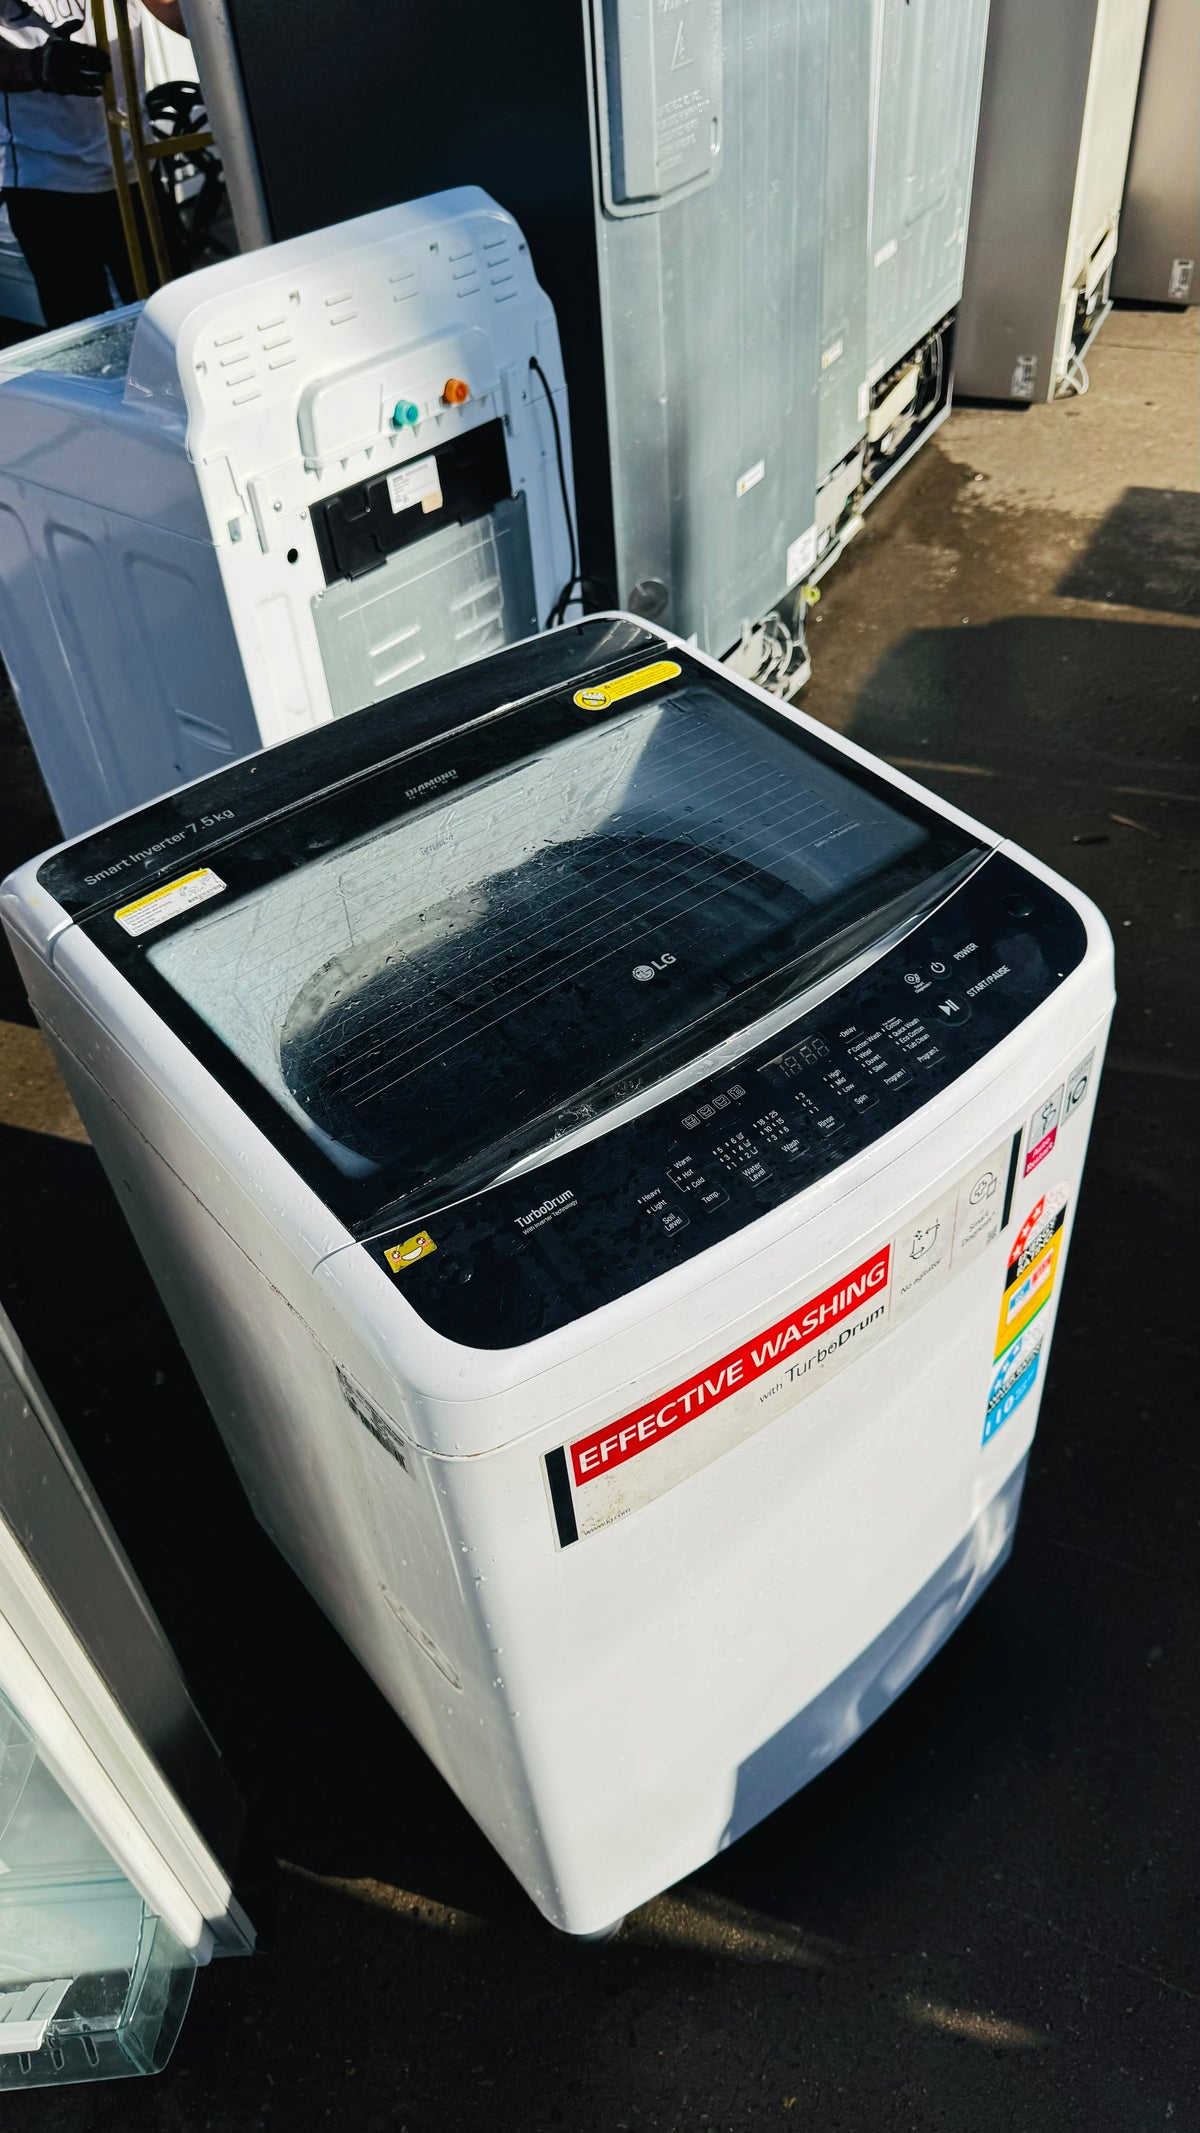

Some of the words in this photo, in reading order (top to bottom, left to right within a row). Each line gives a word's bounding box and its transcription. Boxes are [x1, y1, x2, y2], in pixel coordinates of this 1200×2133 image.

[405, 769, 457, 797] DIAMOND
[84, 859, 131, 885] Smart
[131, 830, 187, 862] Inverter
[953, 942, 979, 960] POWER
[651, 953, 677, 970] LG
[966, 965, 1011, 997] START/PAUSE
[885, 1019, 903, 1030] Cotton
[892, 1026, 907, 1037] Quick
[904, 1018, 920, 1029] Wash
[841, 1026, 857, 1038] Delay
[899, 1034, 911, 1044] Eco
[908, 1026, 925, 1037] Cotton
[851, 1040, 869, 1053] Cotton
[866, 1031, 882, 1042] Wash
[906, 1040, 918, 1049] Tub
[915, 1033, 930, 1045] Clean
[858, 1048, 873, 1059] Wool
[865, 1054, 881, 1066] Duvet
[828, 1069, 842, 1079] High
[872, 1061, 888, 1073] Silent
[835, 1077, 847, 1086] Mid
[842, 1083, 855, 1093] Low
[798, 1091, 806, 1099] 3
[854, 1094, 869, 1105] Spin
[1066, 1076, 1087, 1113] 10
[757, 1118, 766, 1126] 18
[769, 1110, 778, 1119] 25
[763, 1125, 773, 1133] 10
[776, 1117, 785, 1126] 15
[817, 1115, 835, 1128] Rinse
[781, 1139, 800, 1152] Wash
[673, 1155, 692, 1169] Warm
[682, 1168, 695, 1179] Hot
[742, 1162, 761, 1177] Water
[748, 1168, 766, 1182] Level
[691, 1176, 706, 1188] Cold
[641, 1187, 661, 1202] Heavy
[701, 1191, 721, 1204] Temp.
[514, 1190, 574, 1228] TurboDrum
[650, 1199, 667, 1212] Light
[662, 1212, 676, 1225] Soil
[664, 1217, 683, 1232] Level
[760, 1383, 783, 1402] with
[785, 1305, 885, 1382] TurboDrum
[578, 1359, 743, 1474] EFFECTIVE
[750, 1261, 885, 1368] WASHING
[985, 1395, 1014, 1436] 110
